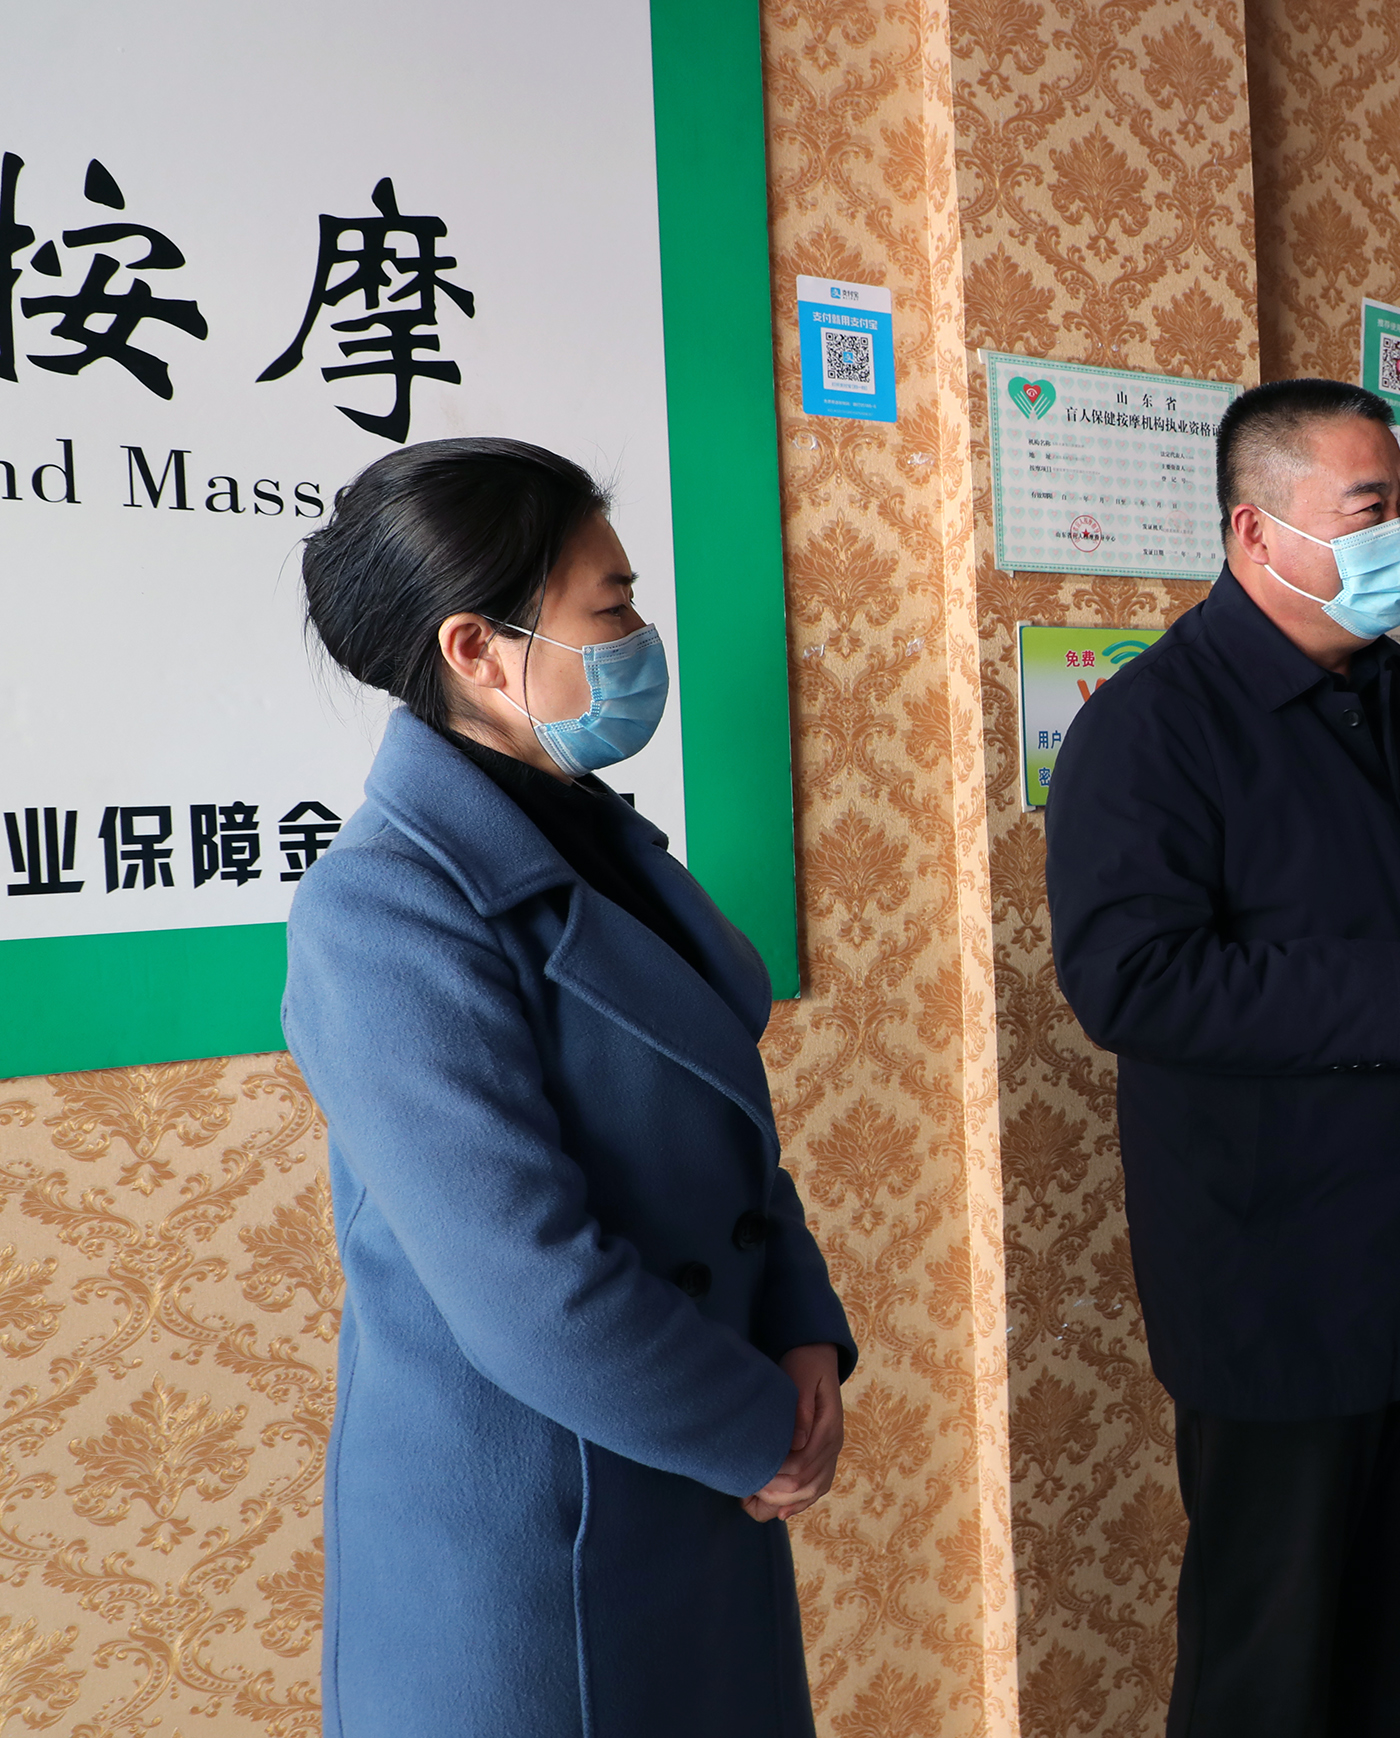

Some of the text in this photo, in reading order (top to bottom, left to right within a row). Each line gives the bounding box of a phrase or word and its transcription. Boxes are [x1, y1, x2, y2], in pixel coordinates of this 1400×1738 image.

[0, 151, 476, 444] 按摩
[1116, 391, 1177, 411] 山东省
[1065, 650, 1096, 668] 免费
